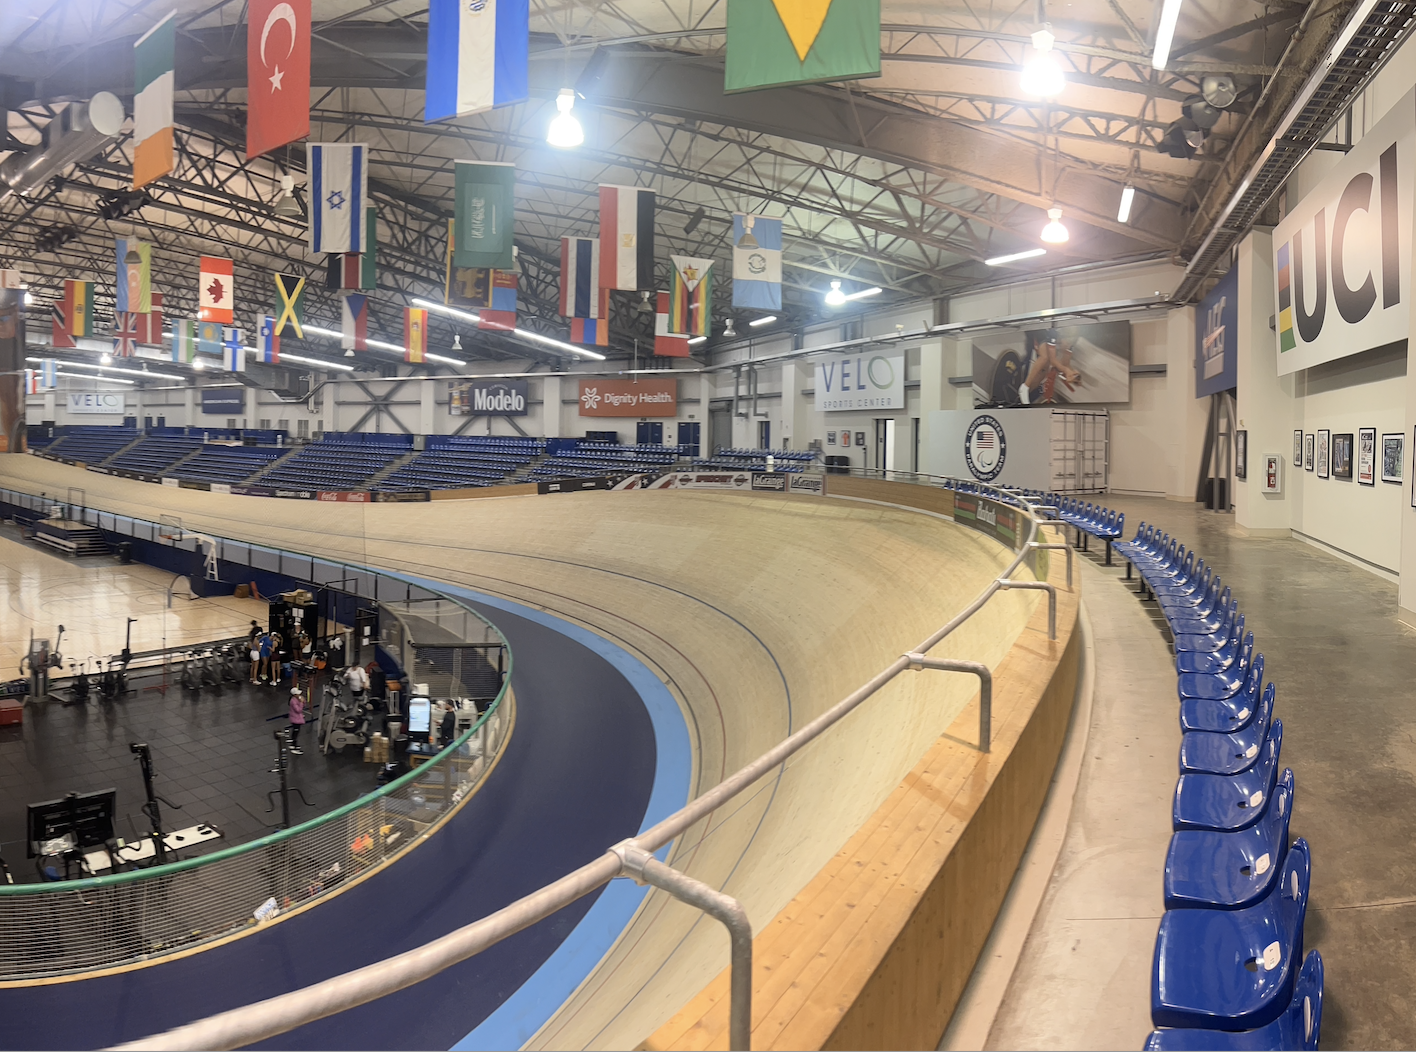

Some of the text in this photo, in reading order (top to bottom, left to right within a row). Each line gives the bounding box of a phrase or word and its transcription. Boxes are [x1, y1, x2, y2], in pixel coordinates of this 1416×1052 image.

[1291, 141, 1401, 343] UCI
[822, 356, 895, 393] VELO
[71, 394, 119, 407] VELO
[473, 388, 524, 411] Modelo
[604, 393, 638, 406] Dignity
[823, 398, 892, 409] SPORTS CENTER
[985, 417, 1004, 437] STATES
